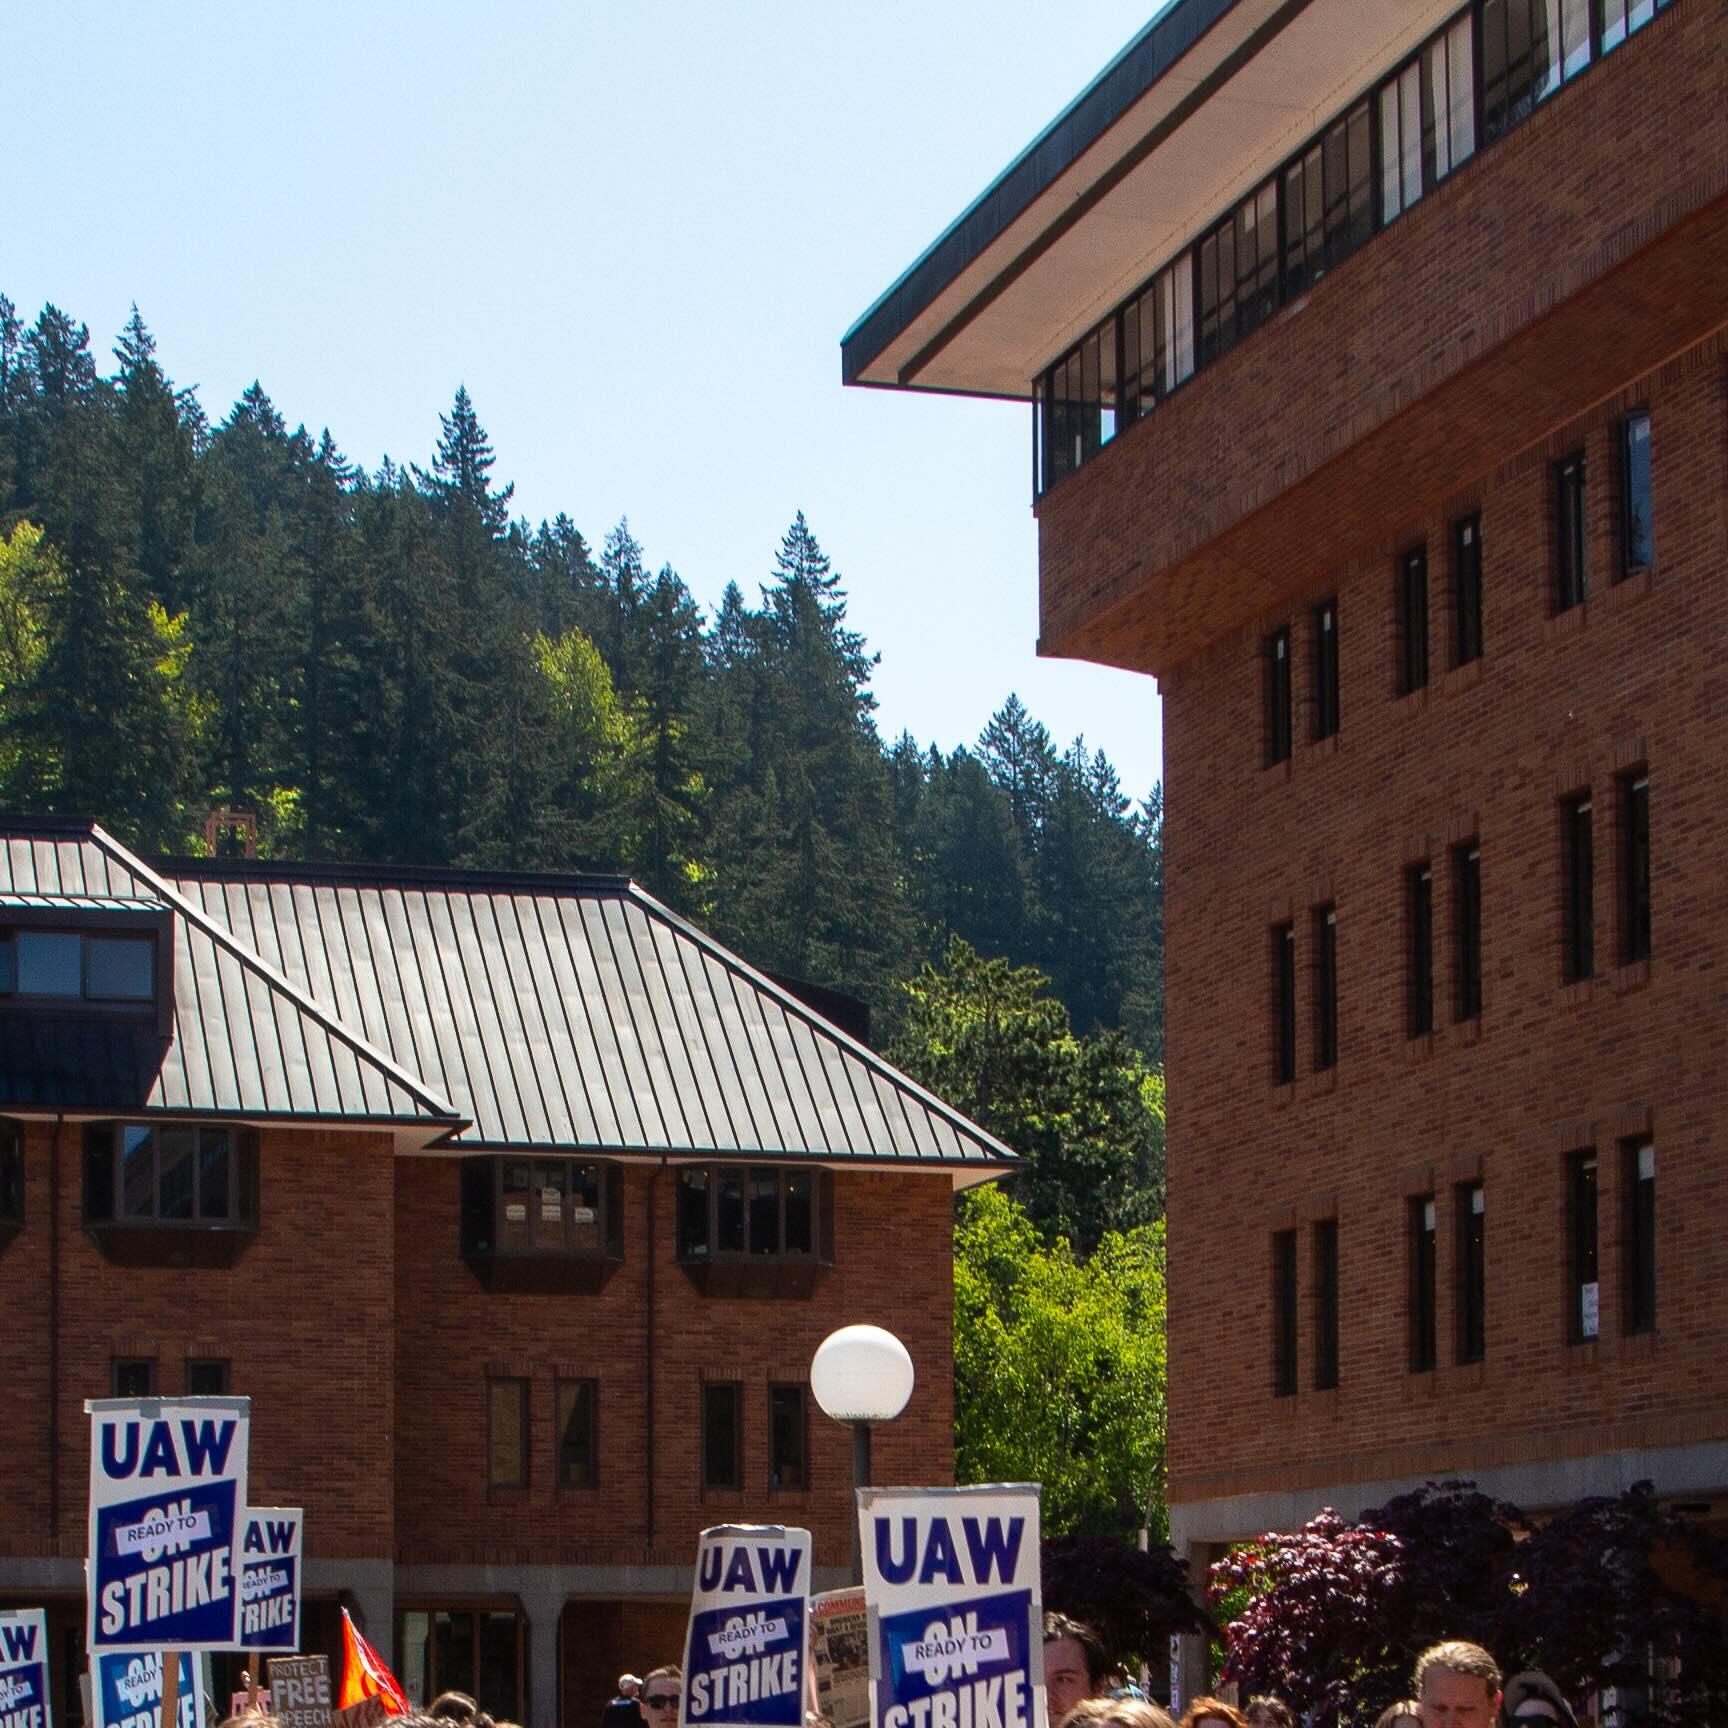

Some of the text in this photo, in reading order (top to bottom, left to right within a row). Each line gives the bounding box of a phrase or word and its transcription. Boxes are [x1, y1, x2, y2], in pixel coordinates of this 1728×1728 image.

[102, 1420, 237, 1480] UAW
[127, 1515, 197, 1543] READY TO
[244, 1521, 296, 1554] AW
[874, 1517, 1025, 1585] UAW
[700, 1546, 802, 1594] UAW
[101, 1546, 230, 1636] STRIKE
[240, 1593, 292, 1635] RIKE
[719, 1621, 777, 1643] READY TO
[915, 1634, 992, 1660] READY TO
[124, 1670, 157, 1689] READY
[272, 1659, 328, 1677] PROTECT
[691, 1650, 798, 1716] STRIKE
[12, 1686, 23, 1696] TO
[273, 1676, 330, 1711] FREE
